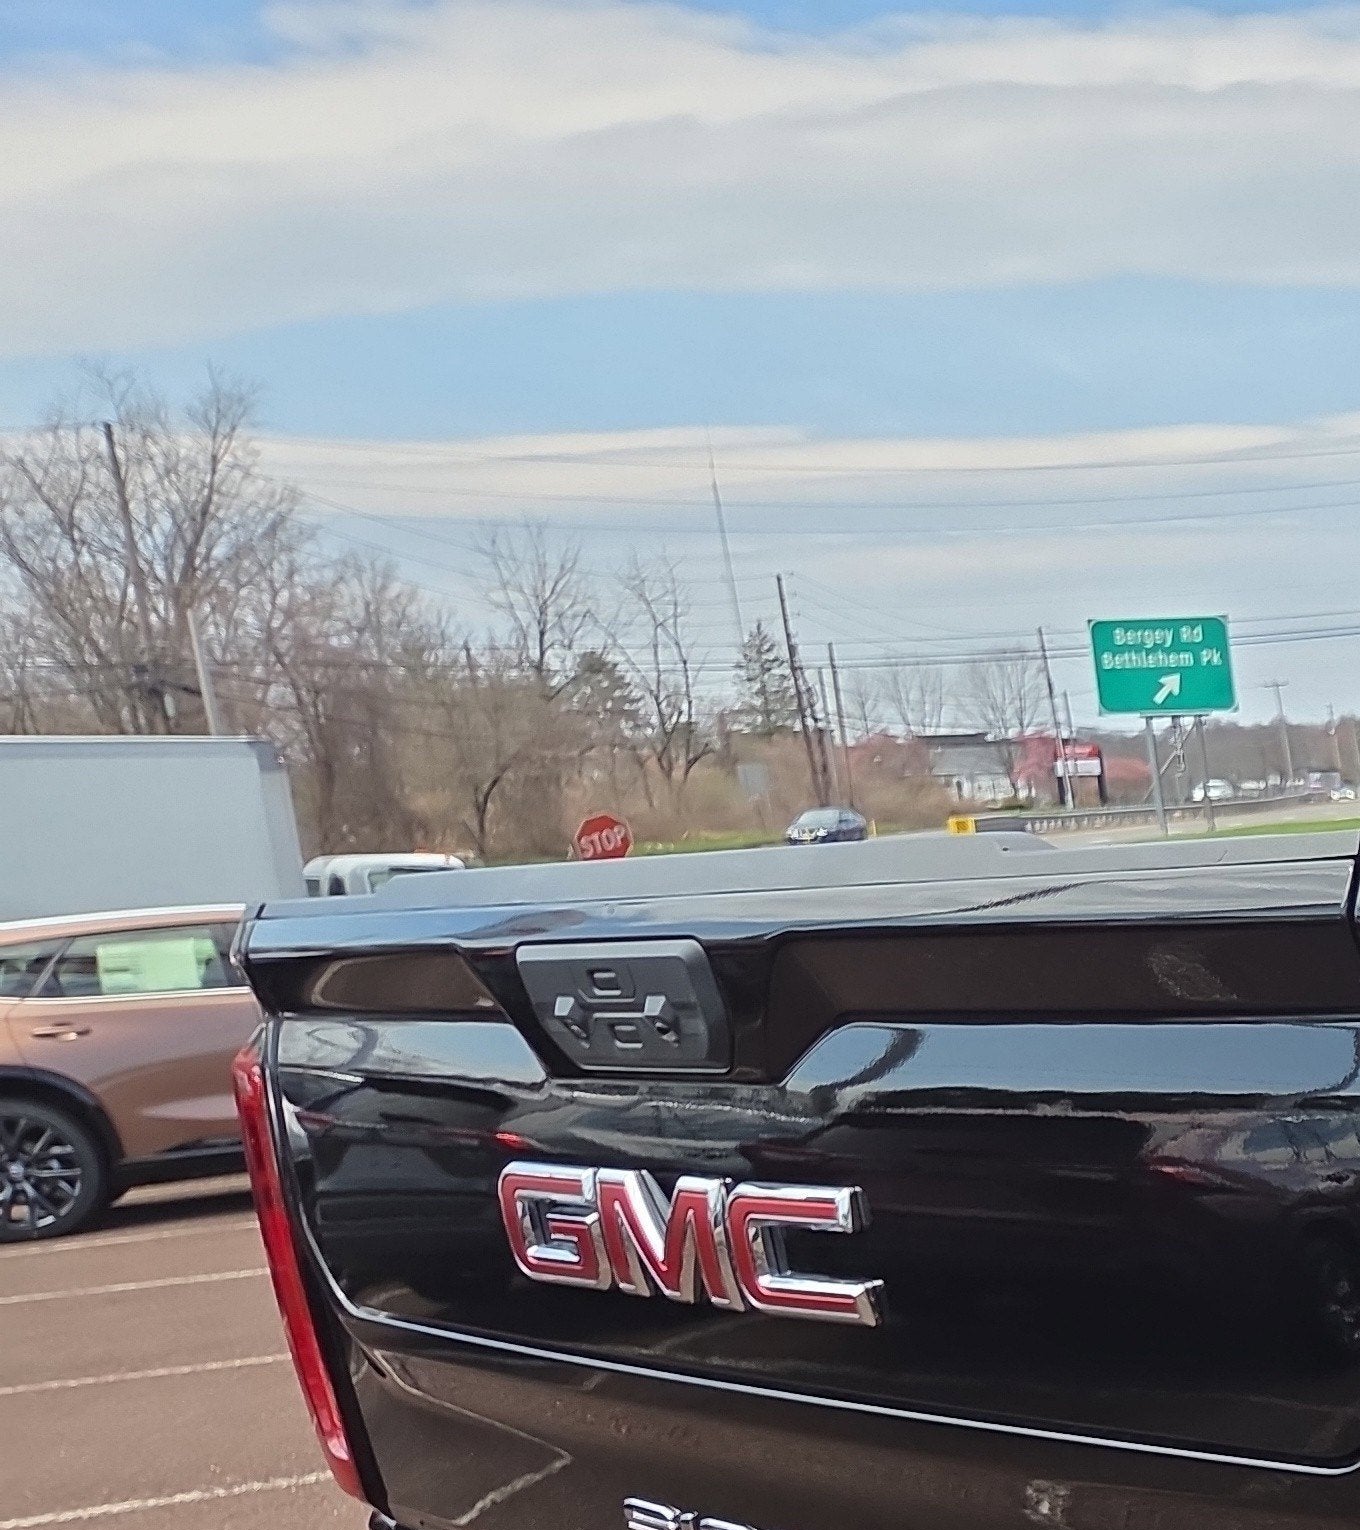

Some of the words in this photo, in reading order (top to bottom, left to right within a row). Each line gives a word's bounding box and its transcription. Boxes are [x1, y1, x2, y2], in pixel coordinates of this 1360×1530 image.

[1112, 626, 1174, 649] Bergey
[1179, 624, 1204, 643] Rd
[1101, 650, 1195, 670] Bethlehem
[1201, 647, 1223, 667] Pk
[579, 825, 626, 859] STOP
[498, 1160, 884, 1328] GMC
